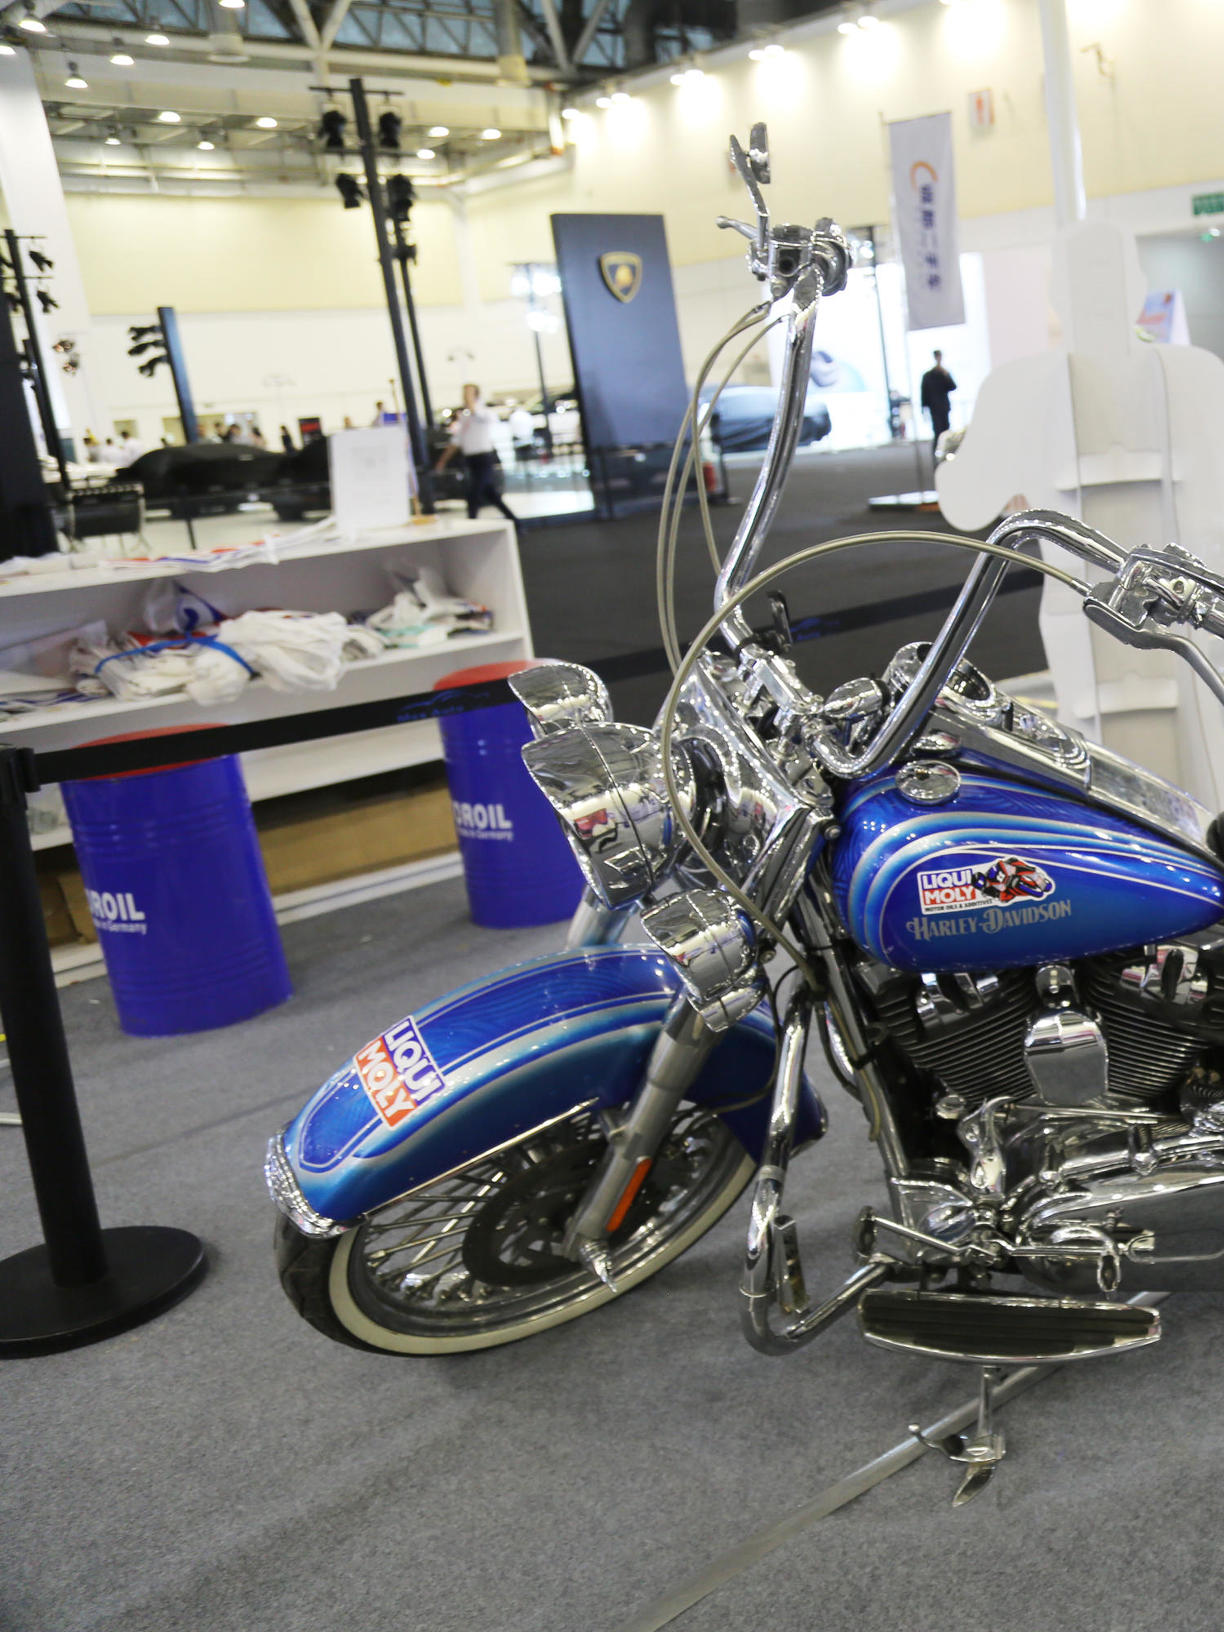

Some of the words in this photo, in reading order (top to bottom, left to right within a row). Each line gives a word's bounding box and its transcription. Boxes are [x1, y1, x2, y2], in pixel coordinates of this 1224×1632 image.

[923, 869, 972, 889] LIQUI
[925, 886, 973, 904] MOLY
[358, 1040, 417, 1118] MOLY
[384, 1020, 442, 1102] LIQUI
